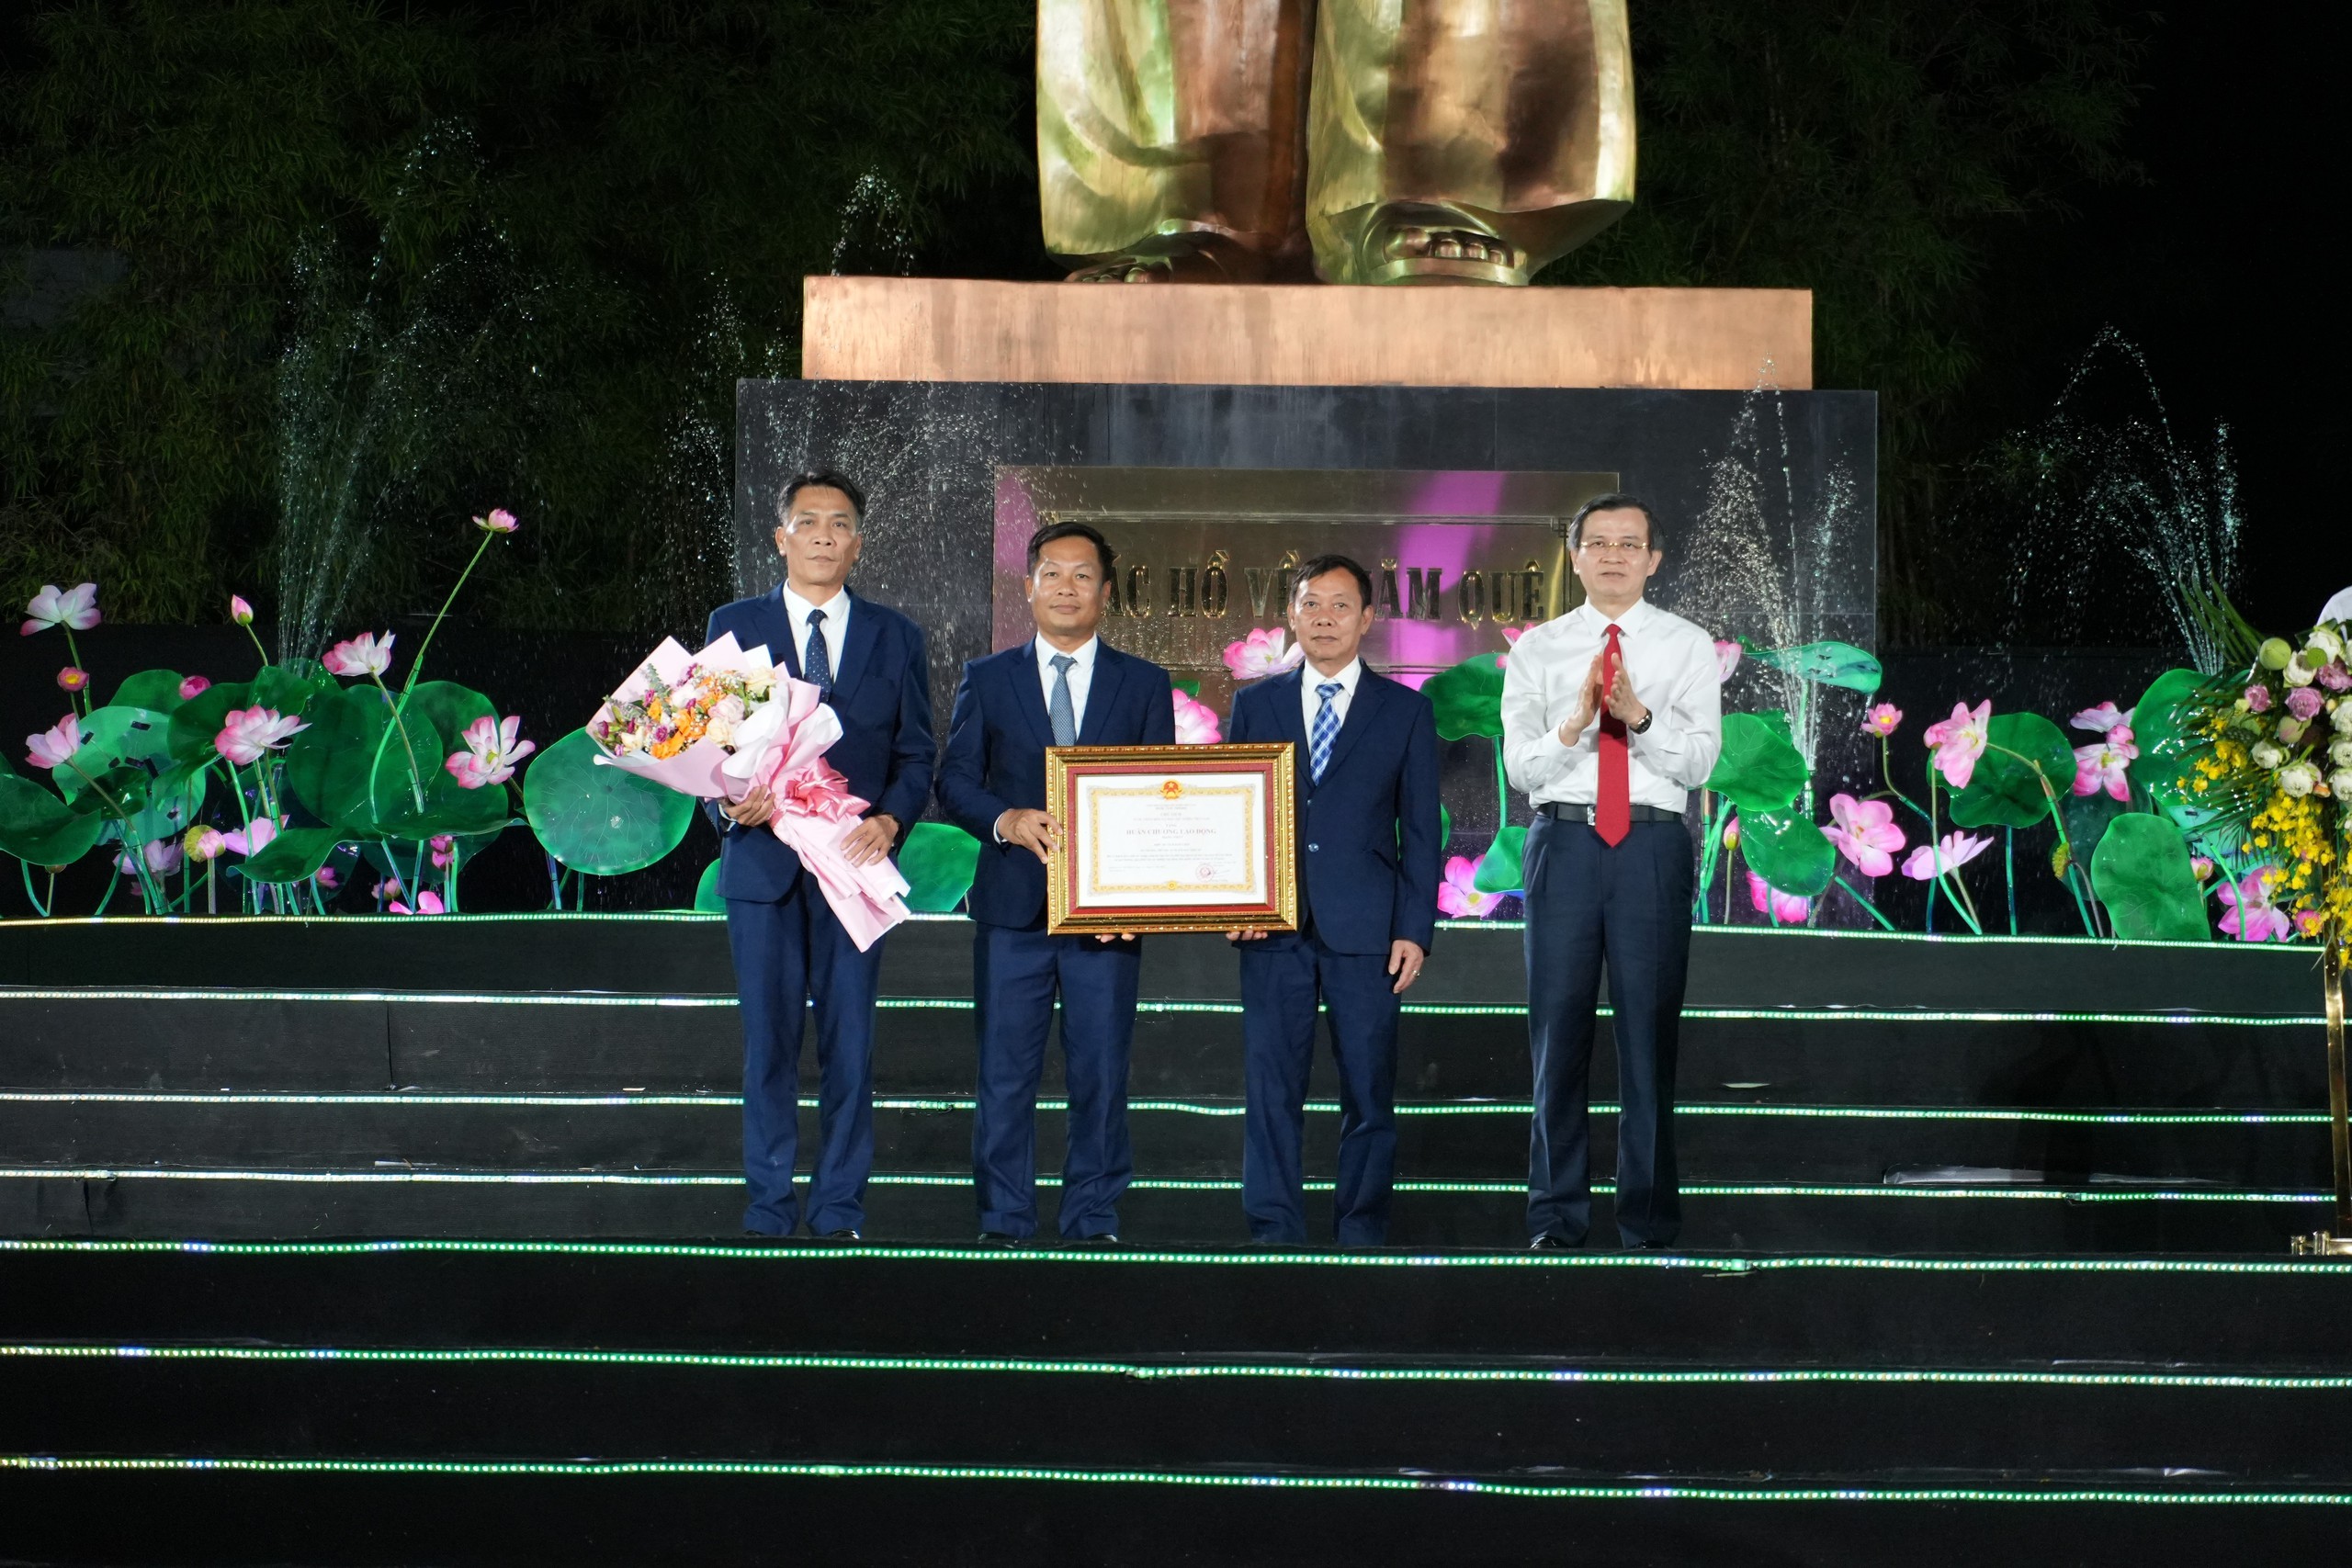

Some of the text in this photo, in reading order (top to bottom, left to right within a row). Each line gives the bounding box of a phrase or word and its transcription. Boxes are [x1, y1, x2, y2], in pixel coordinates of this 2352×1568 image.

[1102, 553, 1150, 618] ÁC
[1168, 549, 1230, 618] HỒ
[1458, 558, 1544, 630] QUÊ
